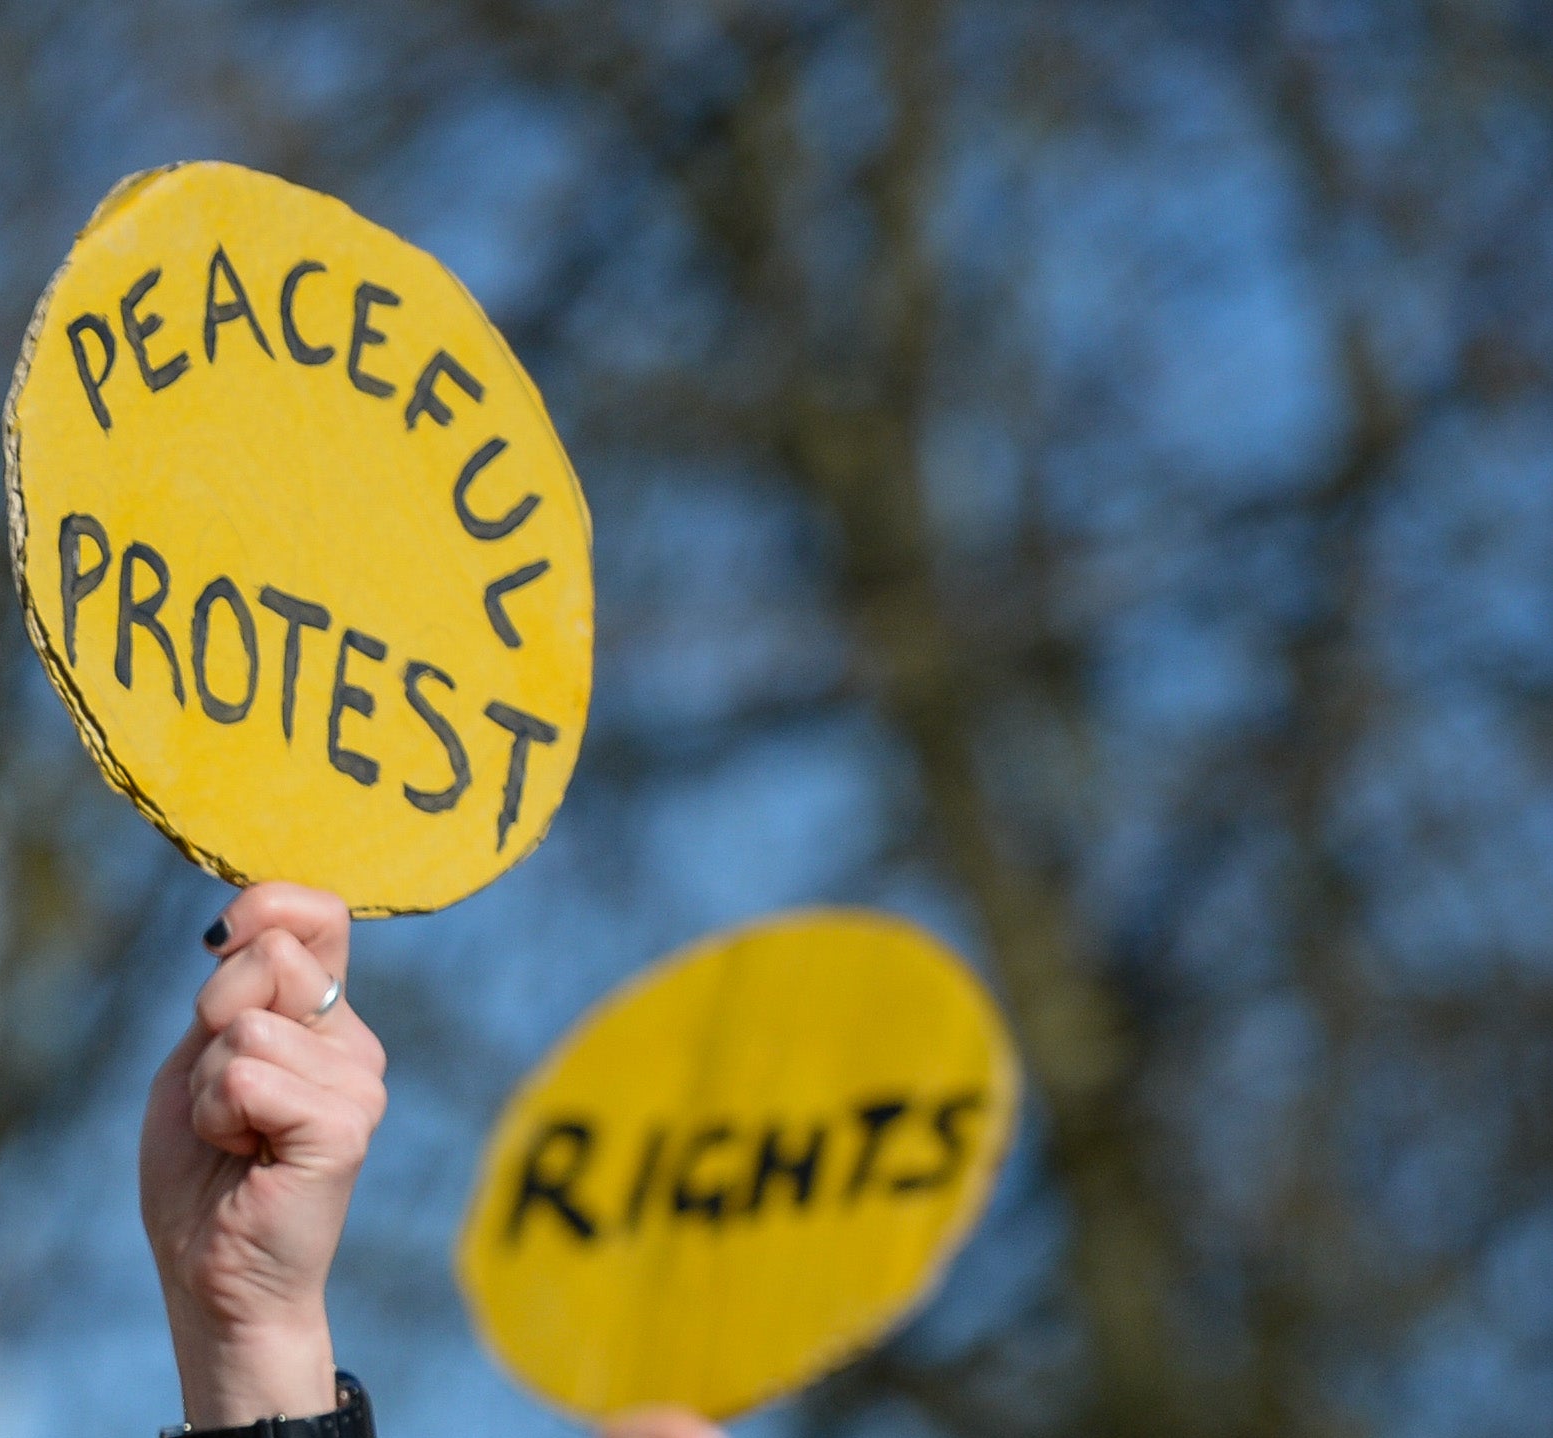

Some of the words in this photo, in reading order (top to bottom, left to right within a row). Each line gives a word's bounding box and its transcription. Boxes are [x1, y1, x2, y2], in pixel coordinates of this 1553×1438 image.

[67, 243, 551, 648] PEACEFUL
[58, 513, 559, 851] PROTEST
[501, 1092, 987, 1252] RIGHTS
